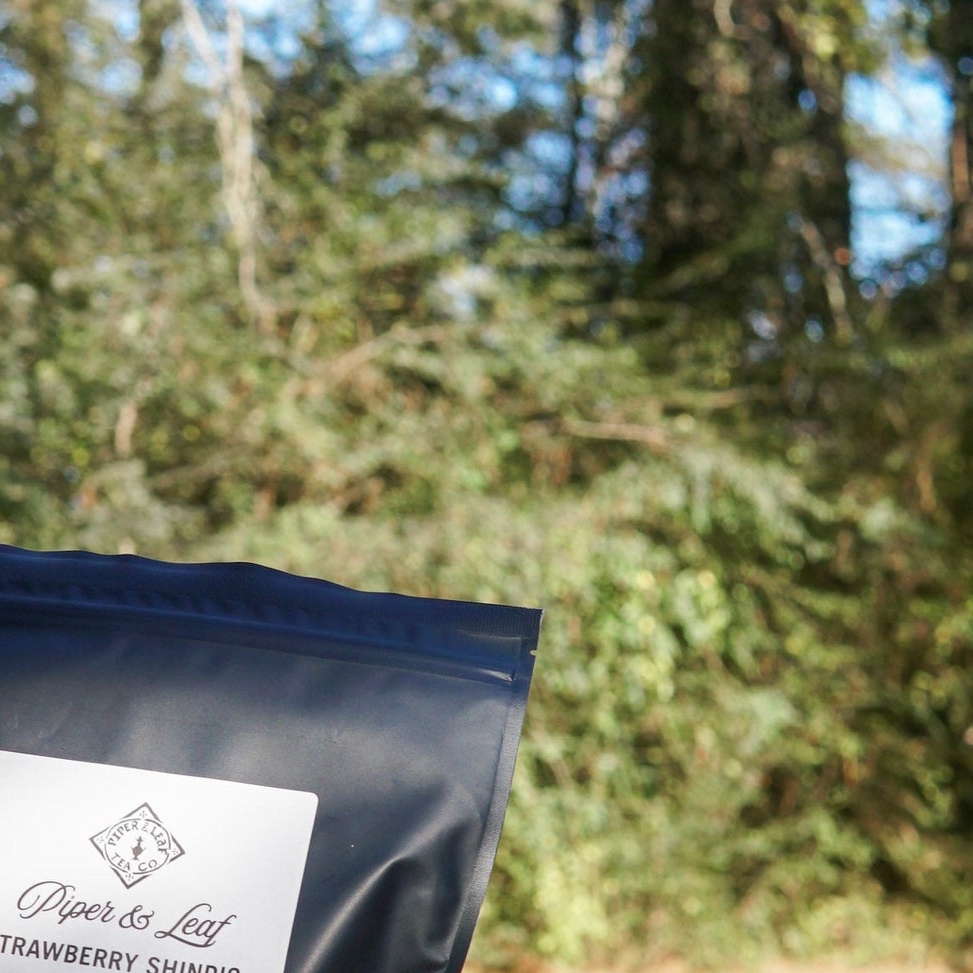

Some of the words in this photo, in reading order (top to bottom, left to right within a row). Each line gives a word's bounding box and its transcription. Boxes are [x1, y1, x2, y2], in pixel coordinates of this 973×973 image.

[108, 821, 138, 846] PIPER
[111, 852, 130, 871] TEA
[17, 880, 115, 924] Piper
[118, 904, 155, 931] &
[154, 903, 237, 948] Leaf
